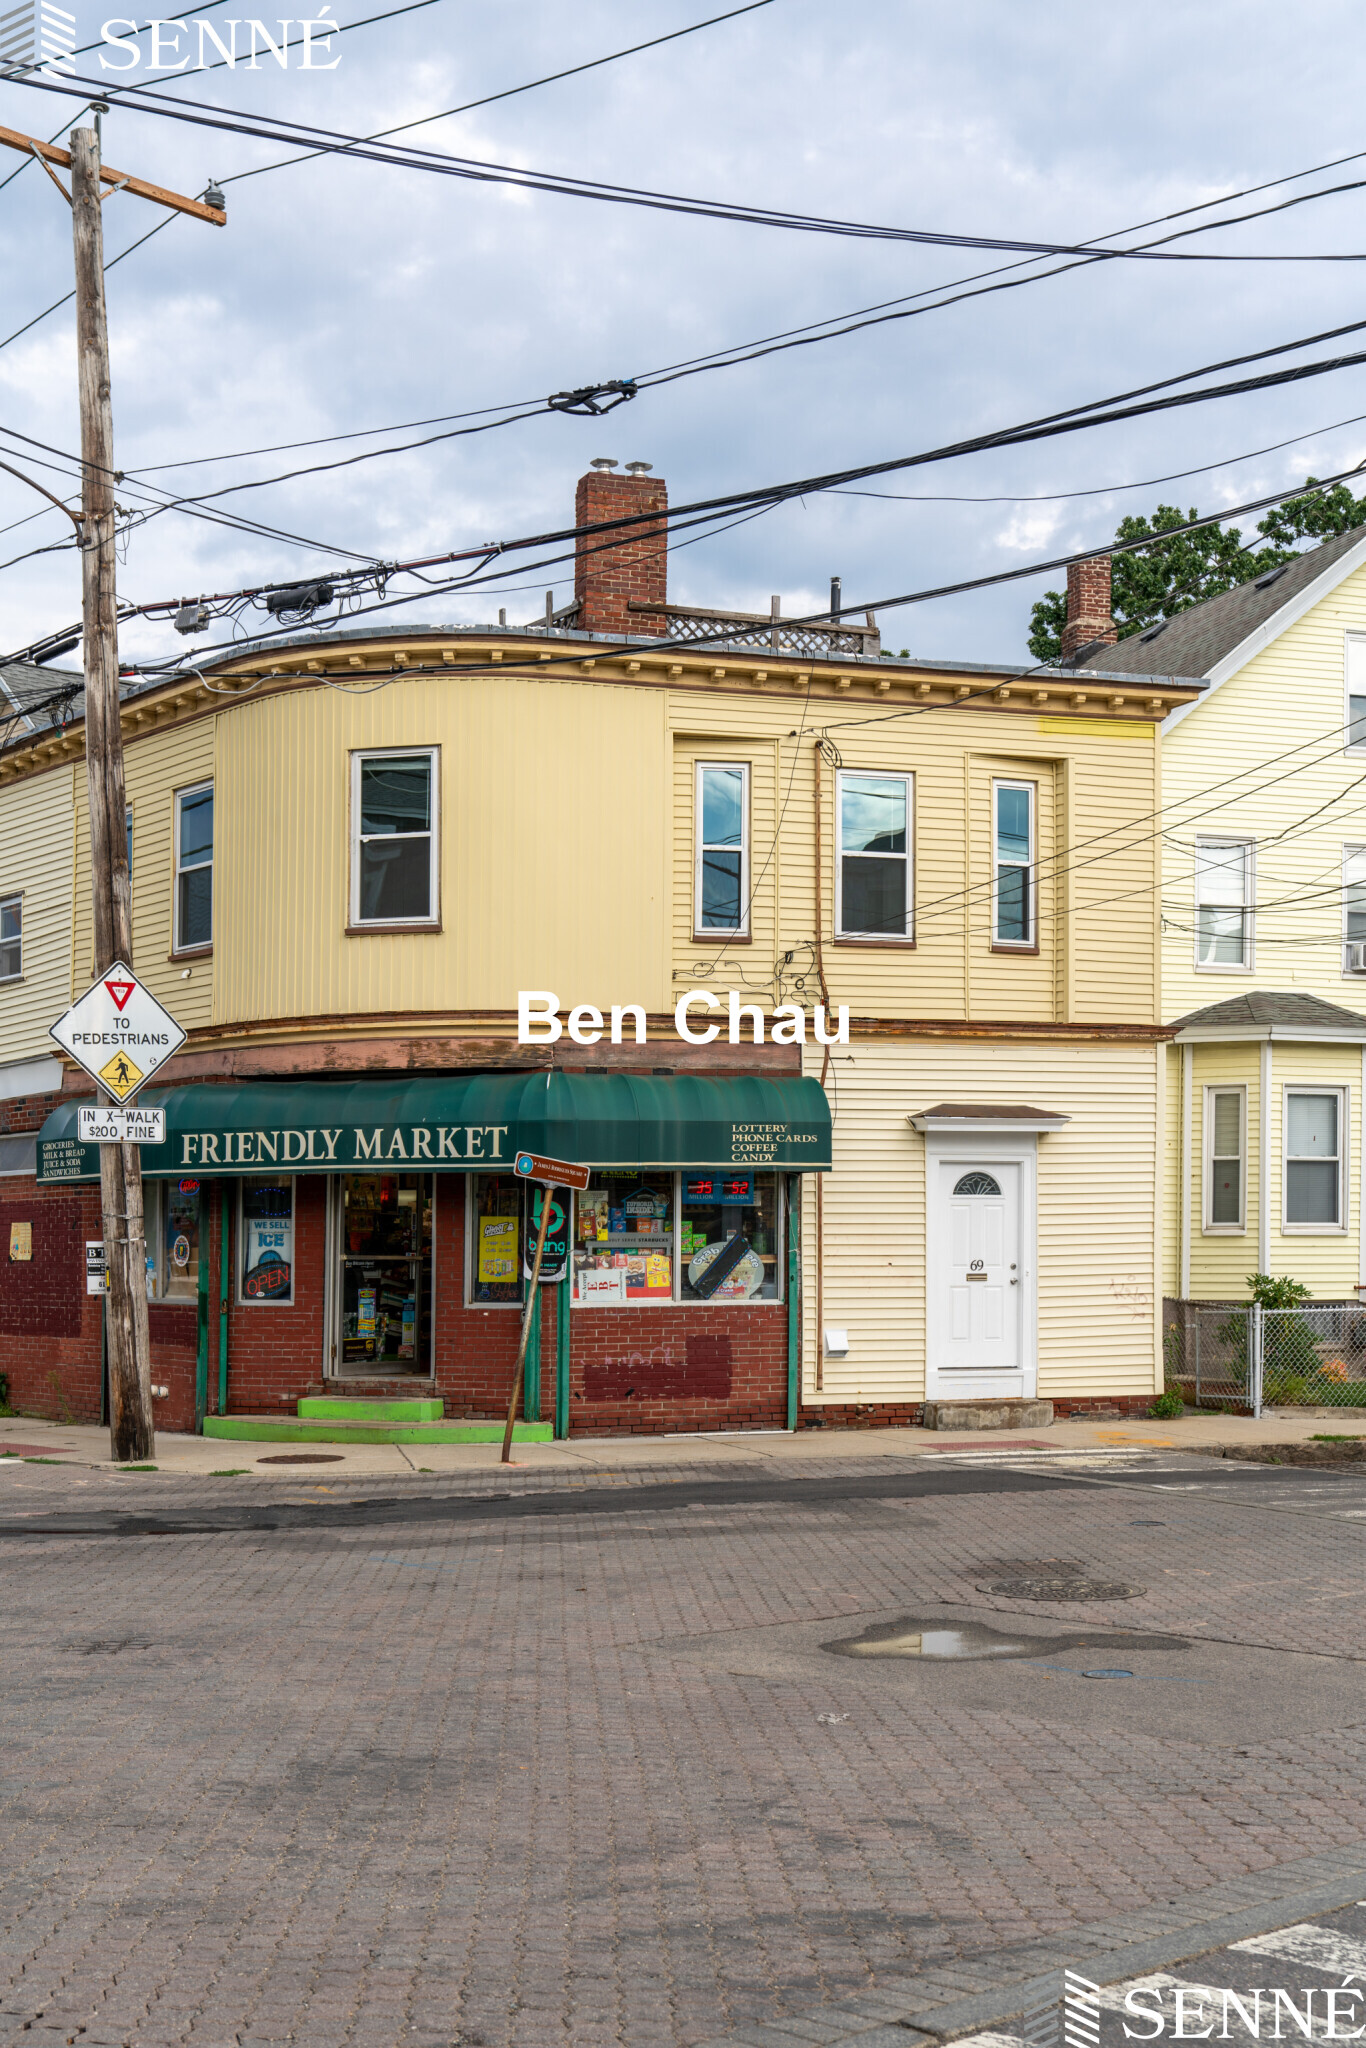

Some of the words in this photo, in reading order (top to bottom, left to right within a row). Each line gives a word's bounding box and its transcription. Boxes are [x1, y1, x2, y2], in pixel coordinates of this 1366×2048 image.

[113, 1018, 130, 1029] TO
[72, 1033, 169, 1045] PEDESTRIANS
[83, 1111, 95, 1122] IN
[89, 1125, 118, 1138] $200
[127, 1126, 155, 1138] FINE
[732, 1124, 787, 1133] LOTTERY
[732, 1133, 773, 1142] PHONE
[775, 1134, 818, 1143] CARDS
[43, 1140, 75, 1151] GROCERIES
[180, 1129, 343, 1164] FRIENDLY
[352, 1125, 509, 1160] MARKET
[731, 1143, 778, 1152] COFFEE
[43, 1151, 58, 1160] MILK
[59, 1150, 64, 1158] &
[65, 1148, 86, 1158] BREAD
[731, 1153, 775, 1162] CANDY
[43, 1160, 59, 1170] JUICE
[66, 1158, 81, 1168] SODA
[42, 1167, 81, 1178] SANDWICHES
[697, 1181, 712, 1194] 35
[732, 1181, 748, 1194] 52
[254, 1221, 267, 1229] WE
[269, 1221, 289, 1229] SELL
[258, 1232, 285, 1247] ICE
[693, 1247, 720, 1266] Grab
[970, 1260, 984, 1271] 69
[247, 1265, 289, 1295] OPEN
[587, 1281, 619, 1291] EBT
